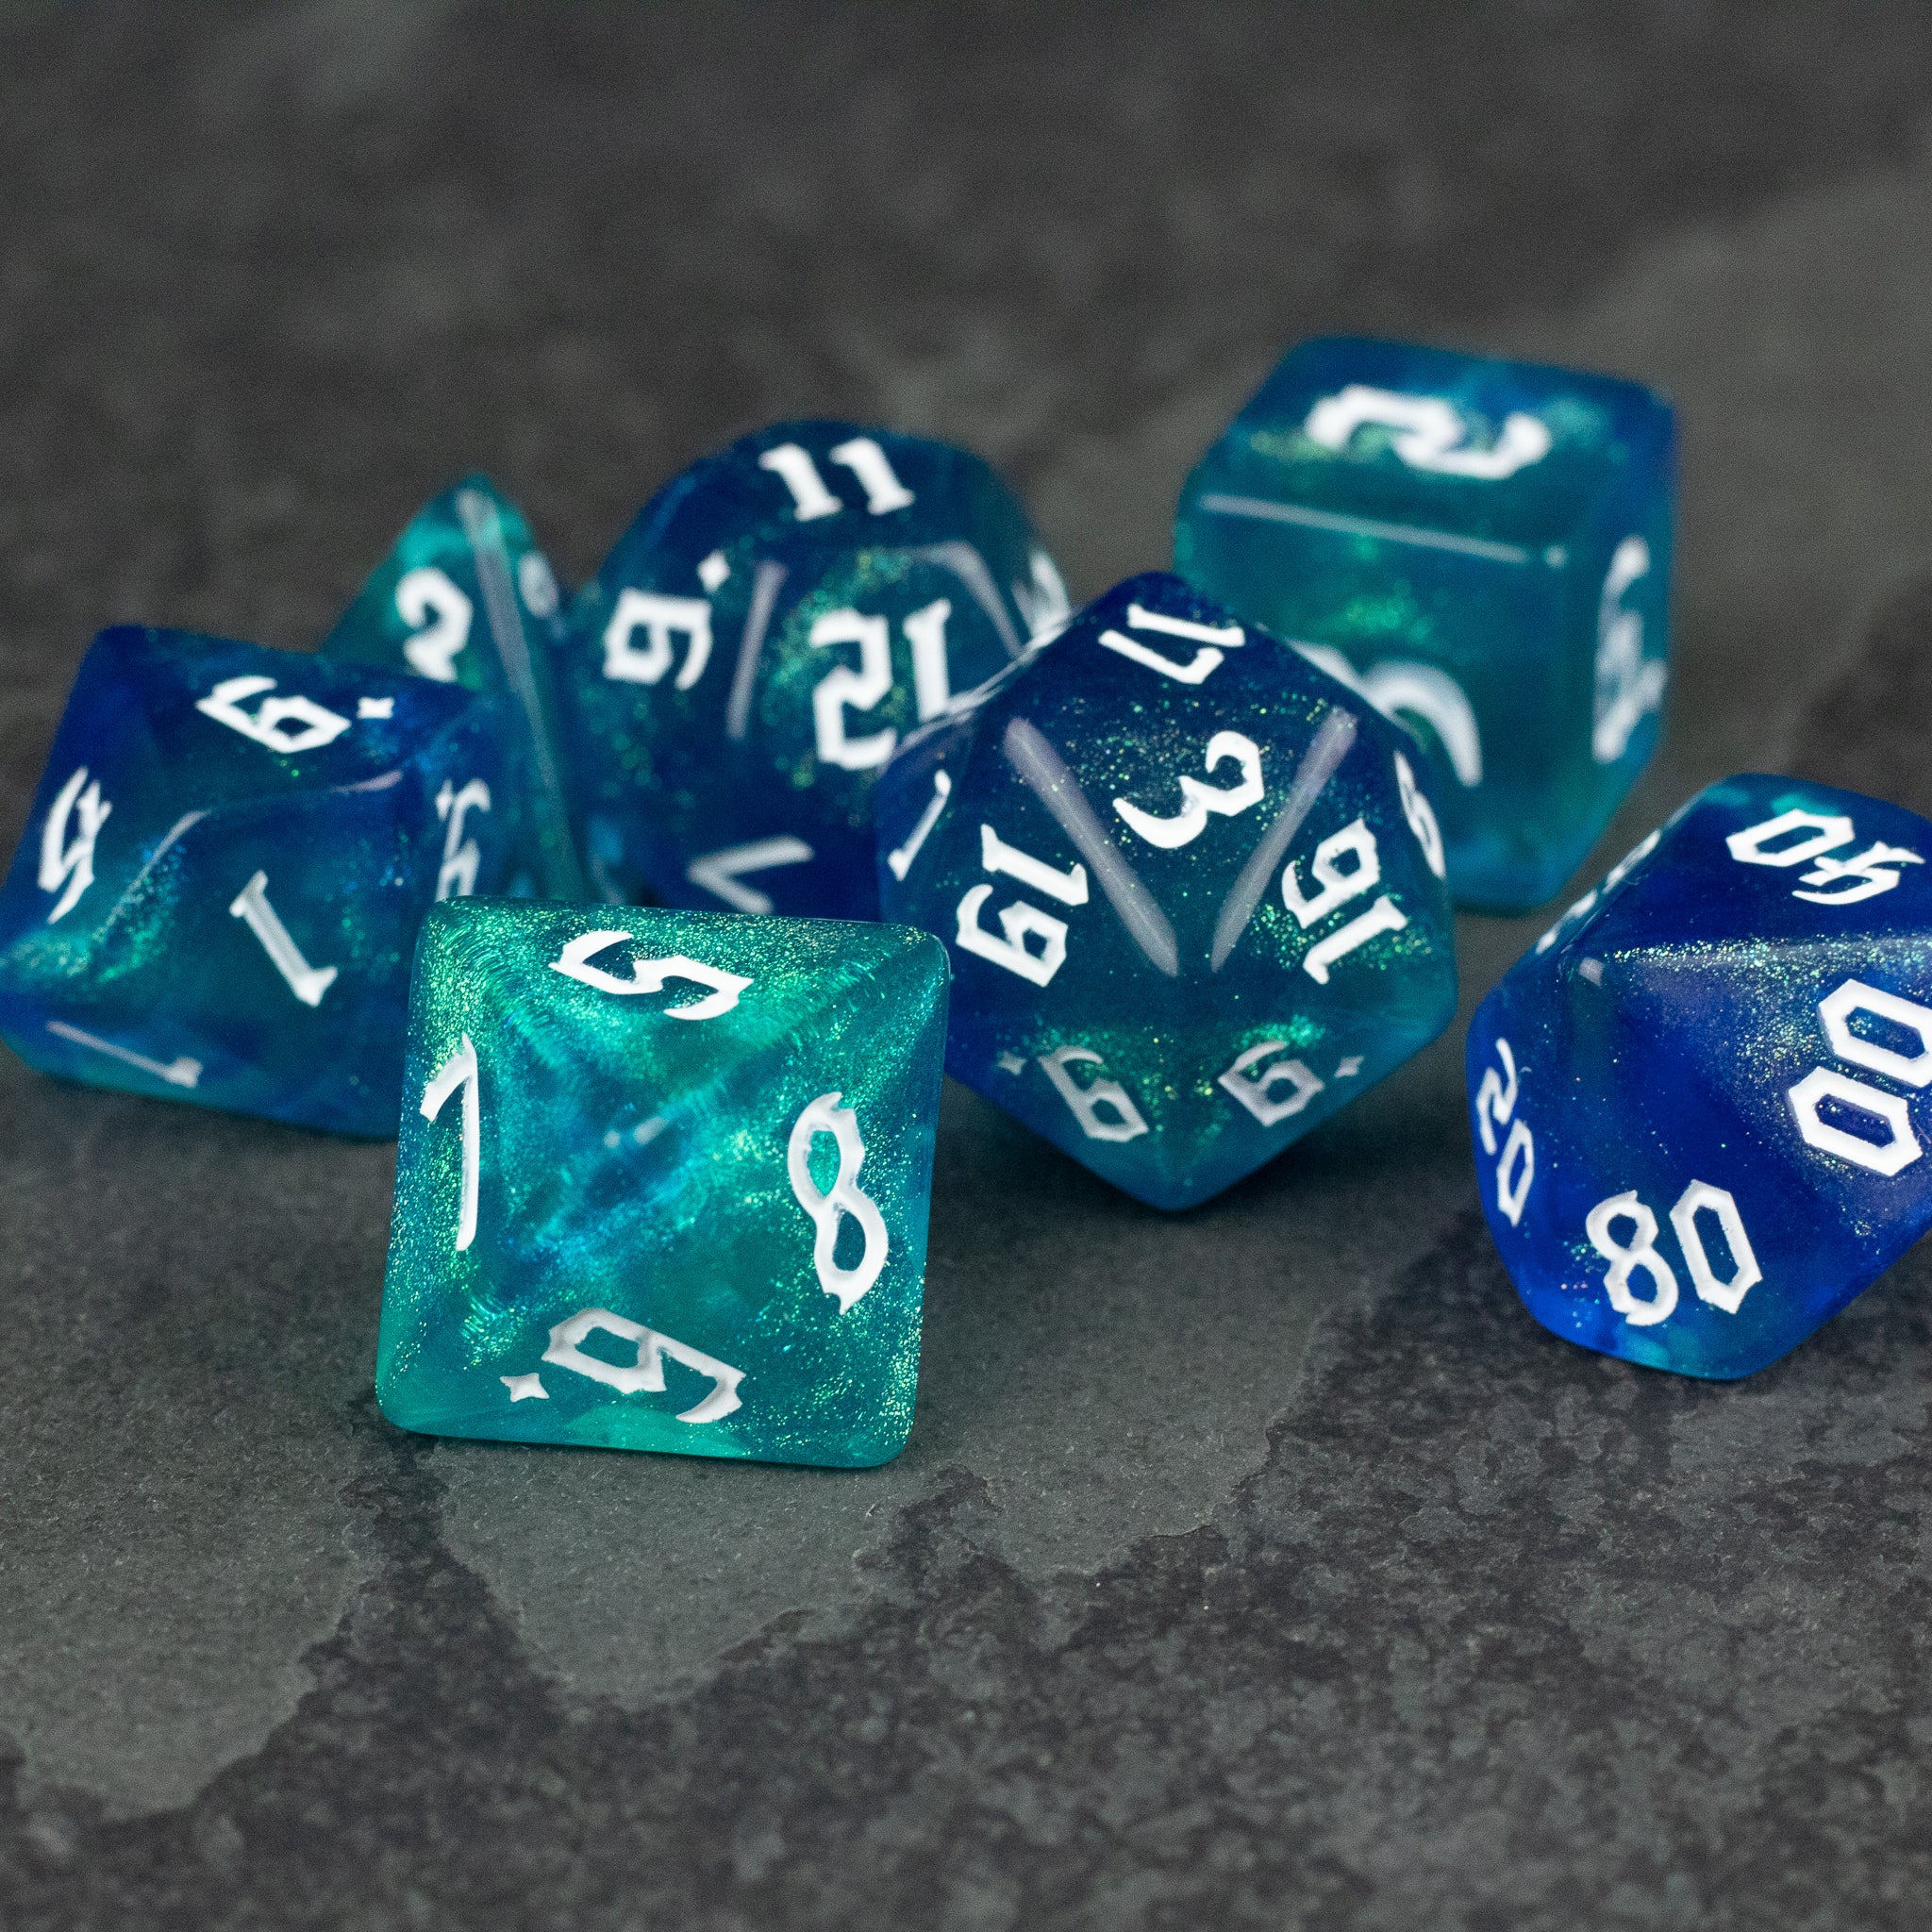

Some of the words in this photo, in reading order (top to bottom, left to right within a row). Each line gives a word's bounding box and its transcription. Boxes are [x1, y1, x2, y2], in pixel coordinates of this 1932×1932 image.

[762, 439, 911, 520] 11
[397, 569, 472, 680] 2
[1099, 605, 1244, 684] 17
[1111, 731, 1265, 849] 3
[956, 824, 1089, 987] 19
[1281, 819, 1408, 985] 16
[1726, 809, 1924, 905] 40
[230, 873, 336, 1006] 1
[550, 930, 755, 1021] 5
[1477, 1039, 1534, 1224] 20
[1786, 976, 1932, 1177] 00
[788, 1091, 891, 1319] 8
[1581, 1180, 1762, 1325] 80
